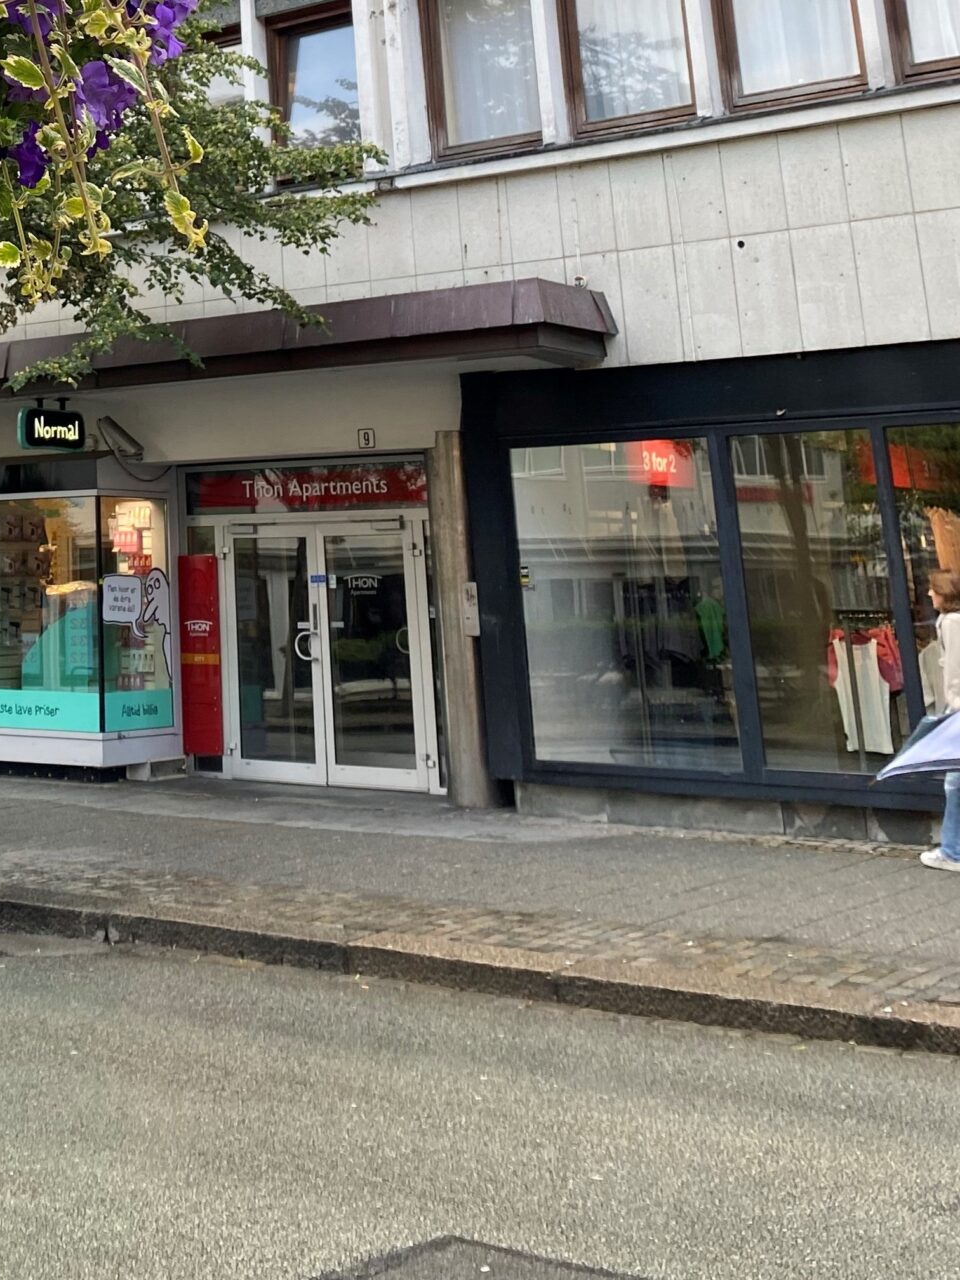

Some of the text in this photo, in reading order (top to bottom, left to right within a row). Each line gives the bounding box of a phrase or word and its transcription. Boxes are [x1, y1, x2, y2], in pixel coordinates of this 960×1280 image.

[34, 415, 79, 440] Normal
[363, 431, 370, 446] 9
[642, 450, 677, 473] 3 for 2
[242, 477, 388, 501] Thon Apartments
[343, 573, 383, 589] THON
[184, 620, 213, 631] THON
[14, 703, 33, 716] lave
